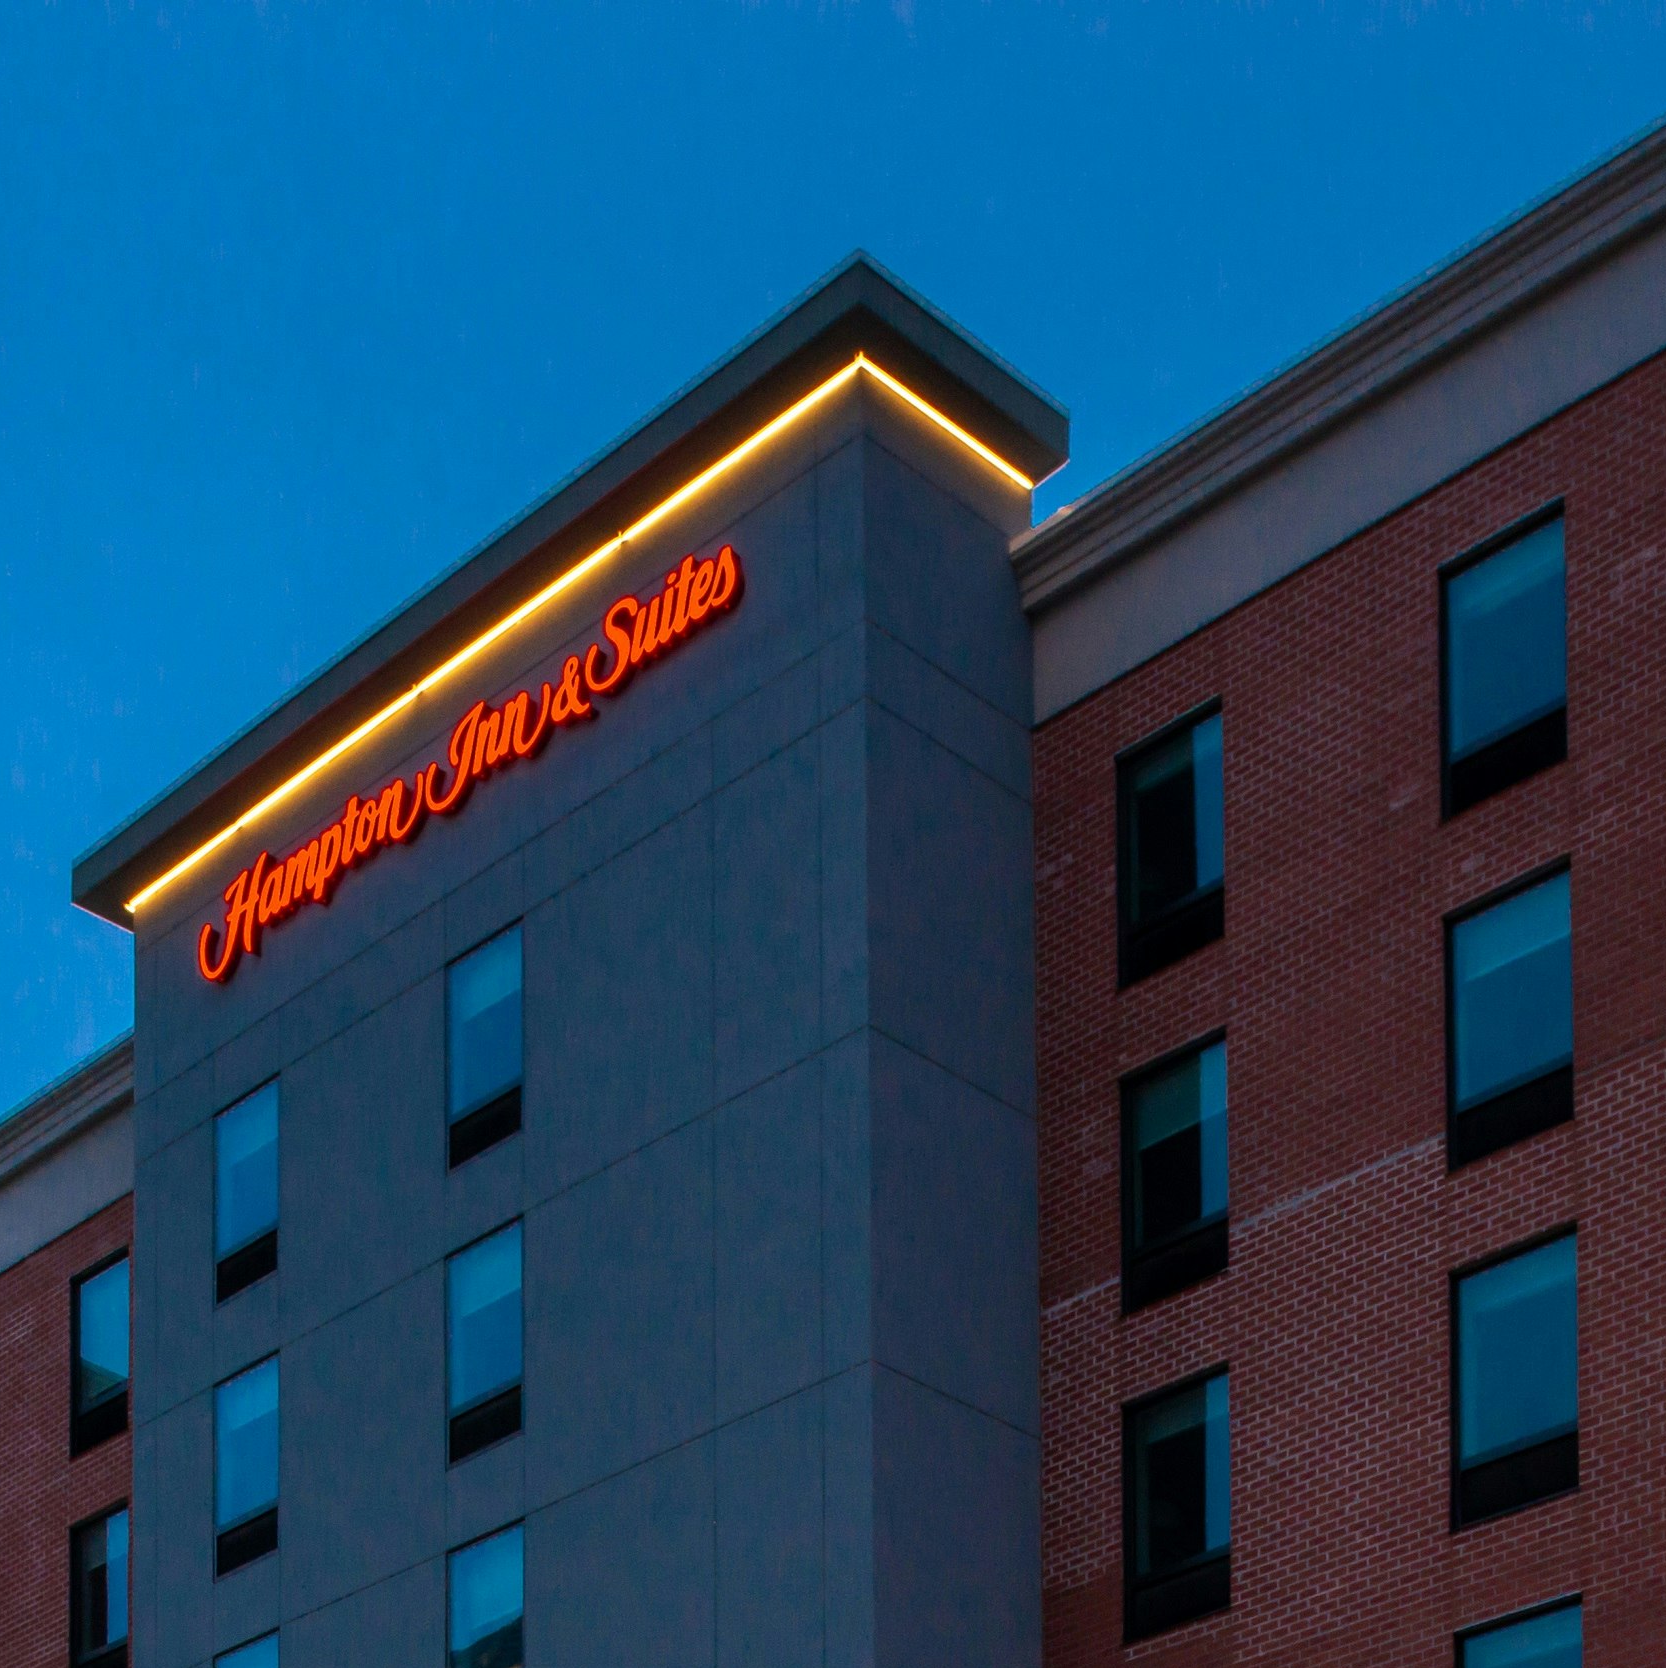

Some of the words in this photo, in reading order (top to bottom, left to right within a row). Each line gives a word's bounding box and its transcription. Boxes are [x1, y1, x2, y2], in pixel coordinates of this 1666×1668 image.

[200, 772, 423, 980] Hampton
[425, 683, 551, 811] Inn
[552, 656, 589, 723] &
[585, 545, 737, 692] Suites
